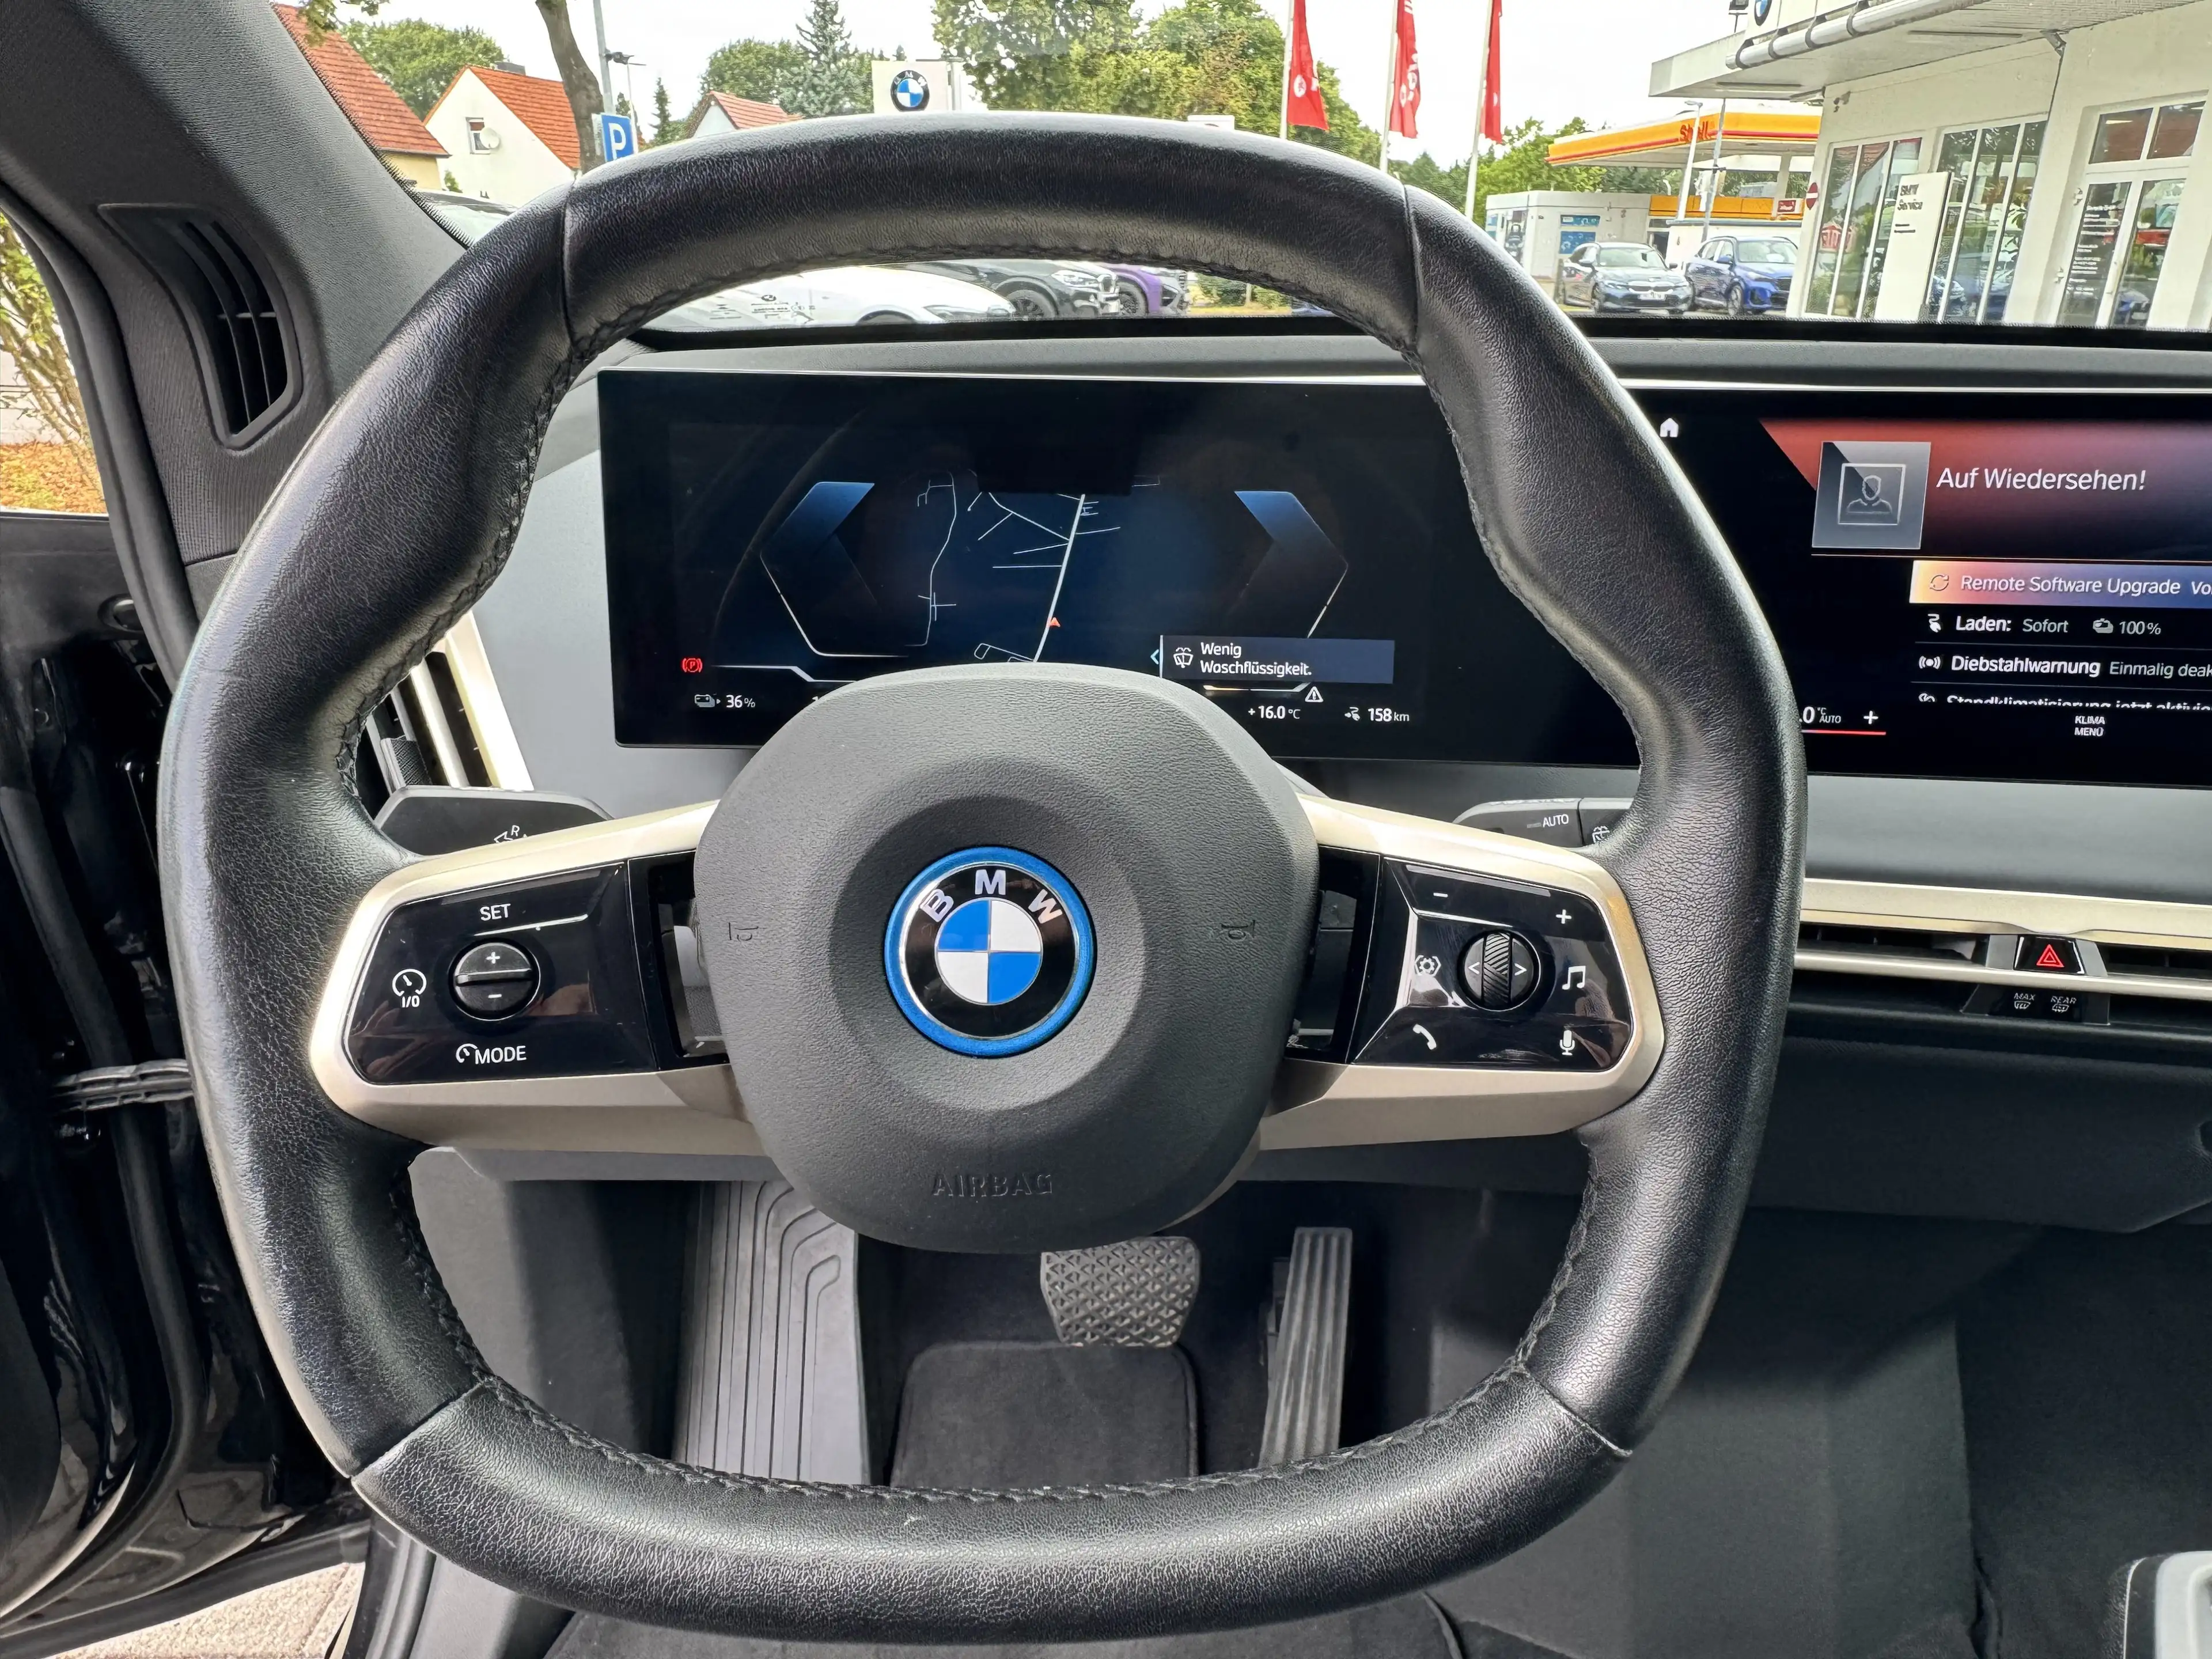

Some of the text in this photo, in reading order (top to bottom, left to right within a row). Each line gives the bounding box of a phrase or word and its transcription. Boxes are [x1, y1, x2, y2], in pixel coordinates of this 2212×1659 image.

[608, 122, 627, 161] P
[1936, 467, 2146, 491] Auf Wiedersehen!
[1960, 575, 2212, 597] Remote Software Upgrade Vo
[1956, 616, 2012, 632] Laden:
[2022, 618, 2069, 633] Sofort
[1200, 642, 1242, 658] Wenig
[1951, 655, 2101, 677] Diebstahlwarnung
[2109, 661, 2174, 679] Einmalig
[1819, 715, 1842, 724] AUTO
[2075, 715, 2105, 725] KLIMA
[511, 824, 520, 836] R
[1542, 813, 1569, 828] AUTO
[920, 868, 1063, 923] BMW
[479, 903, 512, 921] SET
[475, 1044, 527, 1064] MODE
[931, 1173, 1052, 1198] AIRBAG
